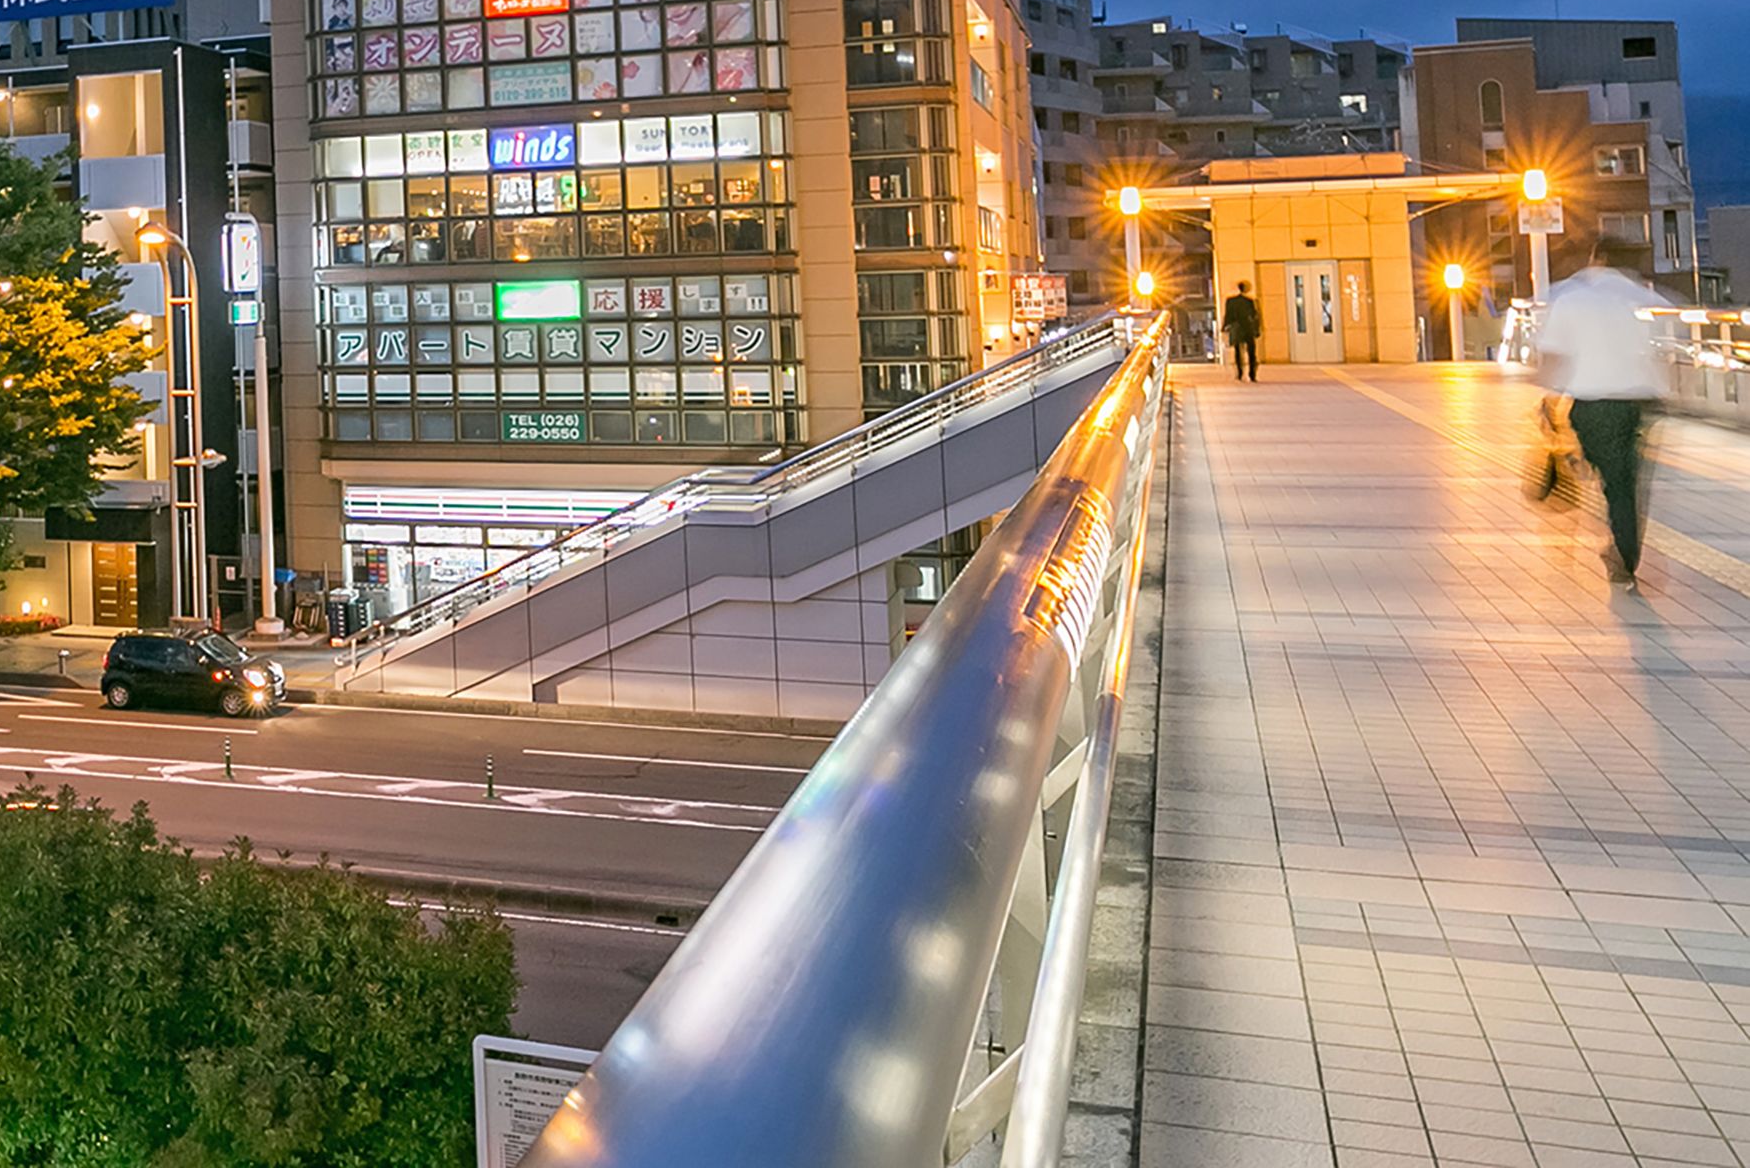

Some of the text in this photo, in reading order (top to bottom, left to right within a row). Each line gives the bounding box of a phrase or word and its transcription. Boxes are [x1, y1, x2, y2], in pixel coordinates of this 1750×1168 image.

[365, 20, 565, 69] オンディーヌ
[494, 130, 573, 165] winds
[337, 325, 765, 359] アパート賃貸マンション
[509, 413, 580, 427] TEL (026)
[509, 427, 580, 440] 229-0550
